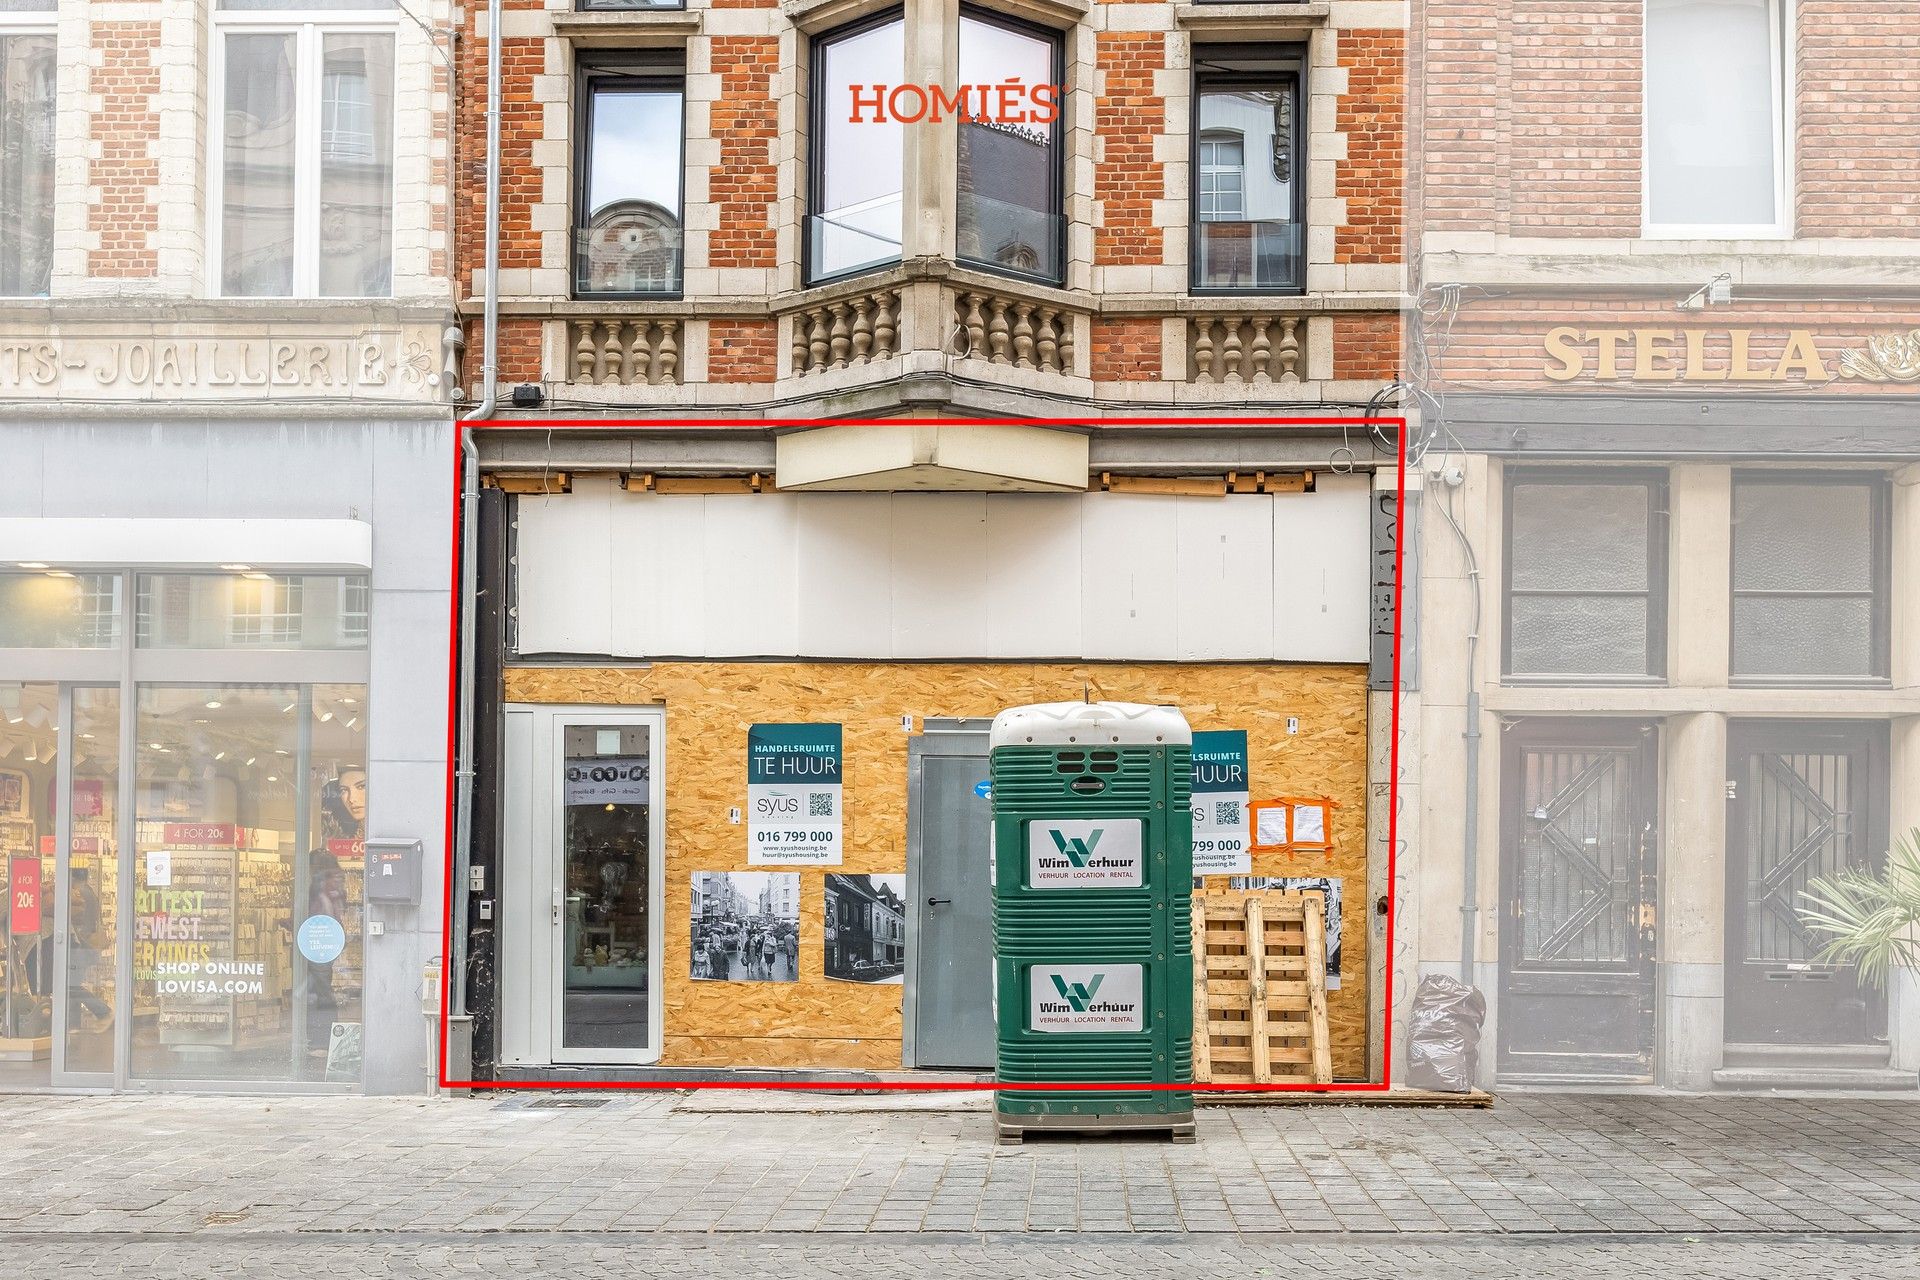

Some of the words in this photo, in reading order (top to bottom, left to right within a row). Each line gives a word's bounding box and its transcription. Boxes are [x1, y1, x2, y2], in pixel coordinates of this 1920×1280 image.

[1544, 326, 1829, 381] STELLA
[1190, 752, 1241, 761] LSRUIMTE
[754, 757, 775, 774] TE
[782, 757, 836, 774] HUUR
[757, 798, 798, 815] syus
[174, 829, 179, 837] 4
[184, 829, 203, 838] FOR
[207, 829, 224, 838] 20€
[757, 831, 780, 842] 016
[784, 831, 807, 842] 799
[810, 831, 833, 842] 000
[1192, 841, 1214, 851] 799
[1218, 840, 1241, 850] 000
[372, 855, 378, 863] 6
[1039, 858, 1069, 868] Wim
[17, 891, 34, 908] 20€
[157, 962, 200, 975] SHOP
[205, 962, 264, 975] ONLINE
[157, 980, 263, 994] LOVISA.COM
[1040, 1003, 1070, 1012] Wim
